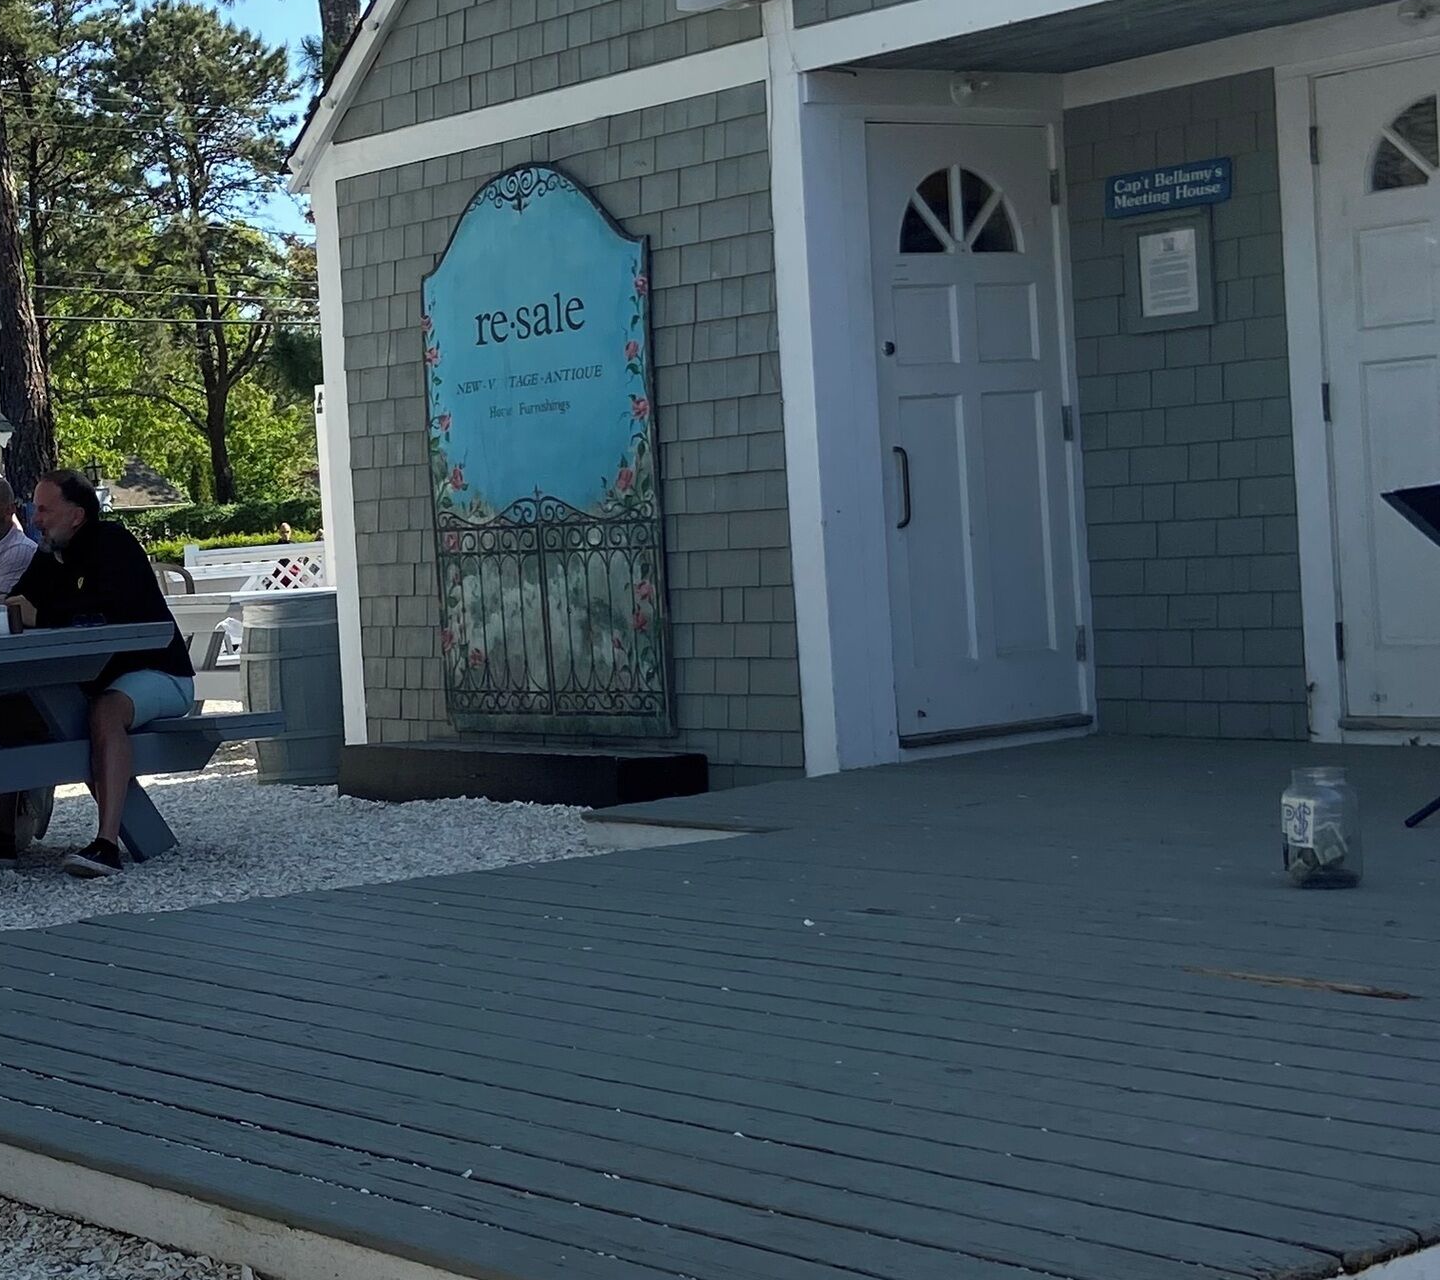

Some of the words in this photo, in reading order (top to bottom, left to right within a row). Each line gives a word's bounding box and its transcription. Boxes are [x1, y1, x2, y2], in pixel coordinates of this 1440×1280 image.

[1114, 176, 1150, 194] Cap't
[1154, 166, 1223, 188] Bellamy's
[1114, 190, 1170, 209] Meeting
[1175, 183, 1221, 200] House
[456, 380, 482, 395] NEW
[544, 364, 603, 384] ANTIQUE
[519, 399, 571, 416] Furnishings
